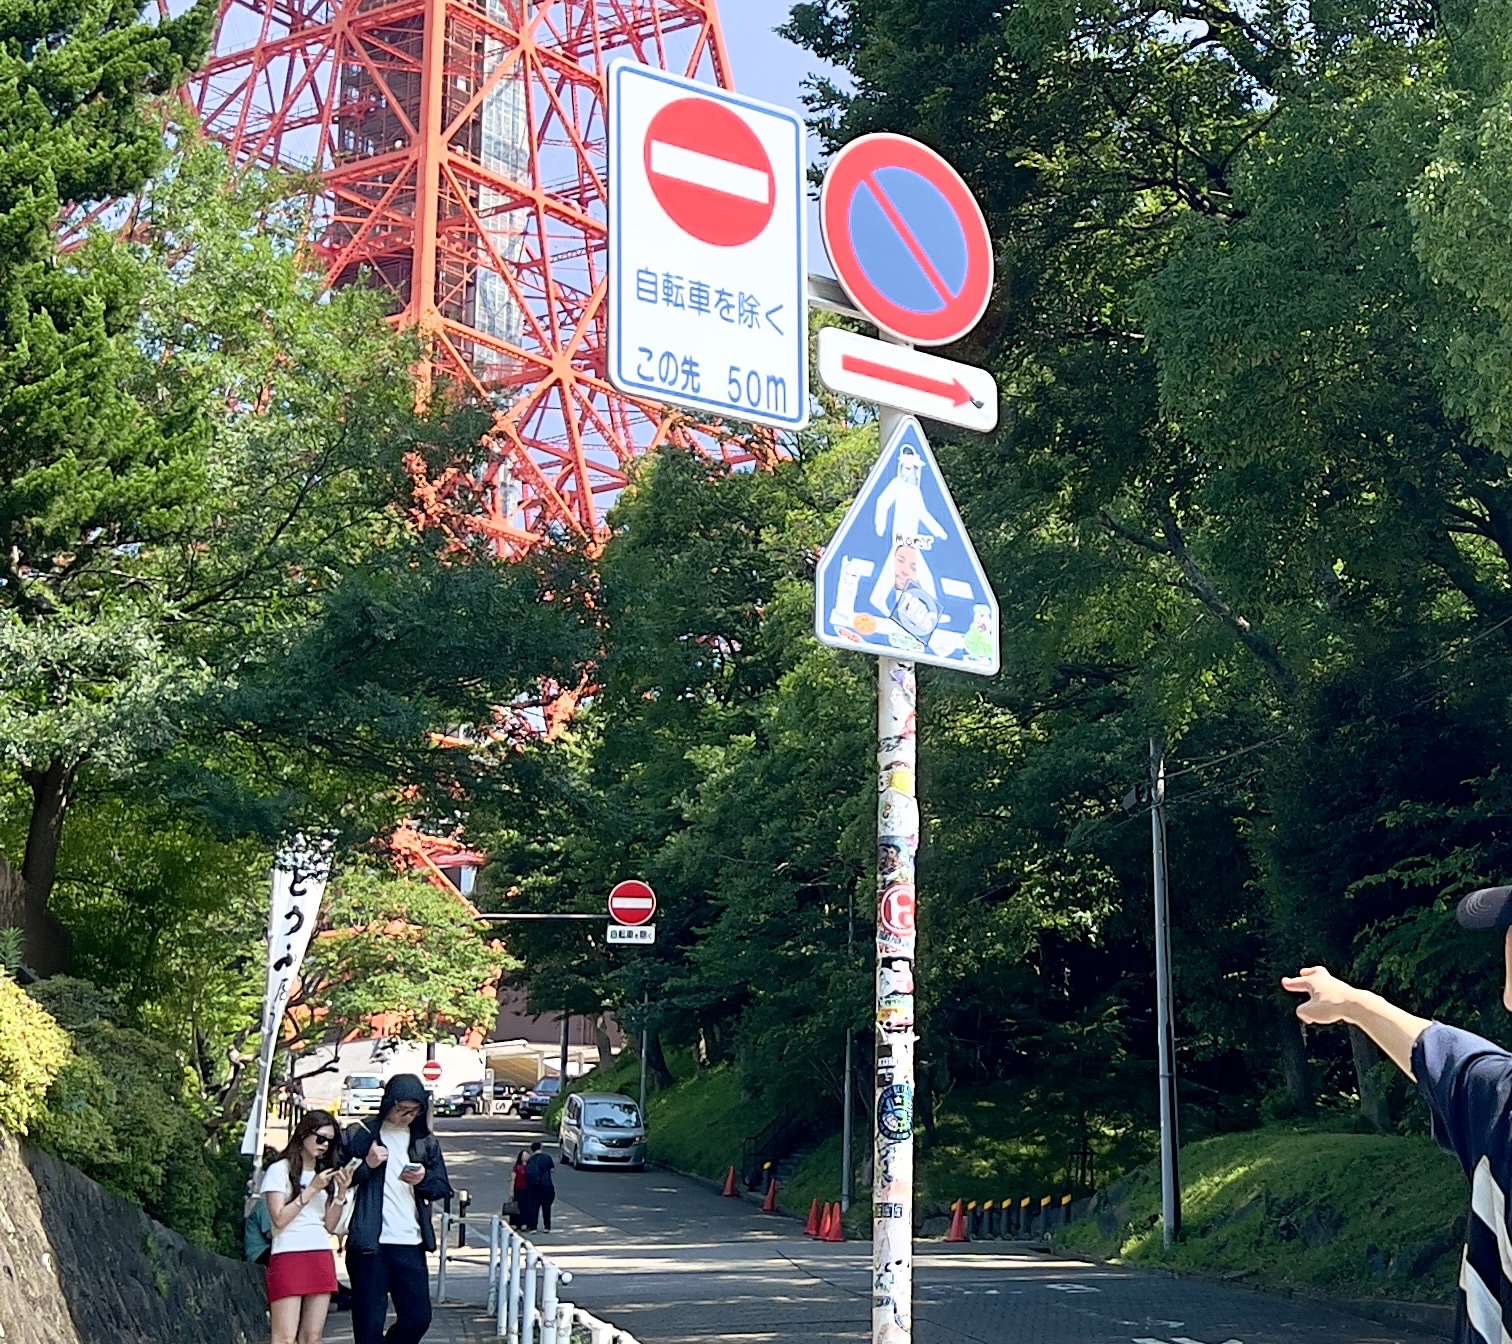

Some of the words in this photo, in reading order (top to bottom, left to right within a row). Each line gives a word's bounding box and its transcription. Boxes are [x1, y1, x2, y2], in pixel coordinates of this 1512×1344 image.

[636, 267, 784, 336] 自転車を除く
[636, 346, 701, 394] この先
[727, 364, 787, 414] 50m
